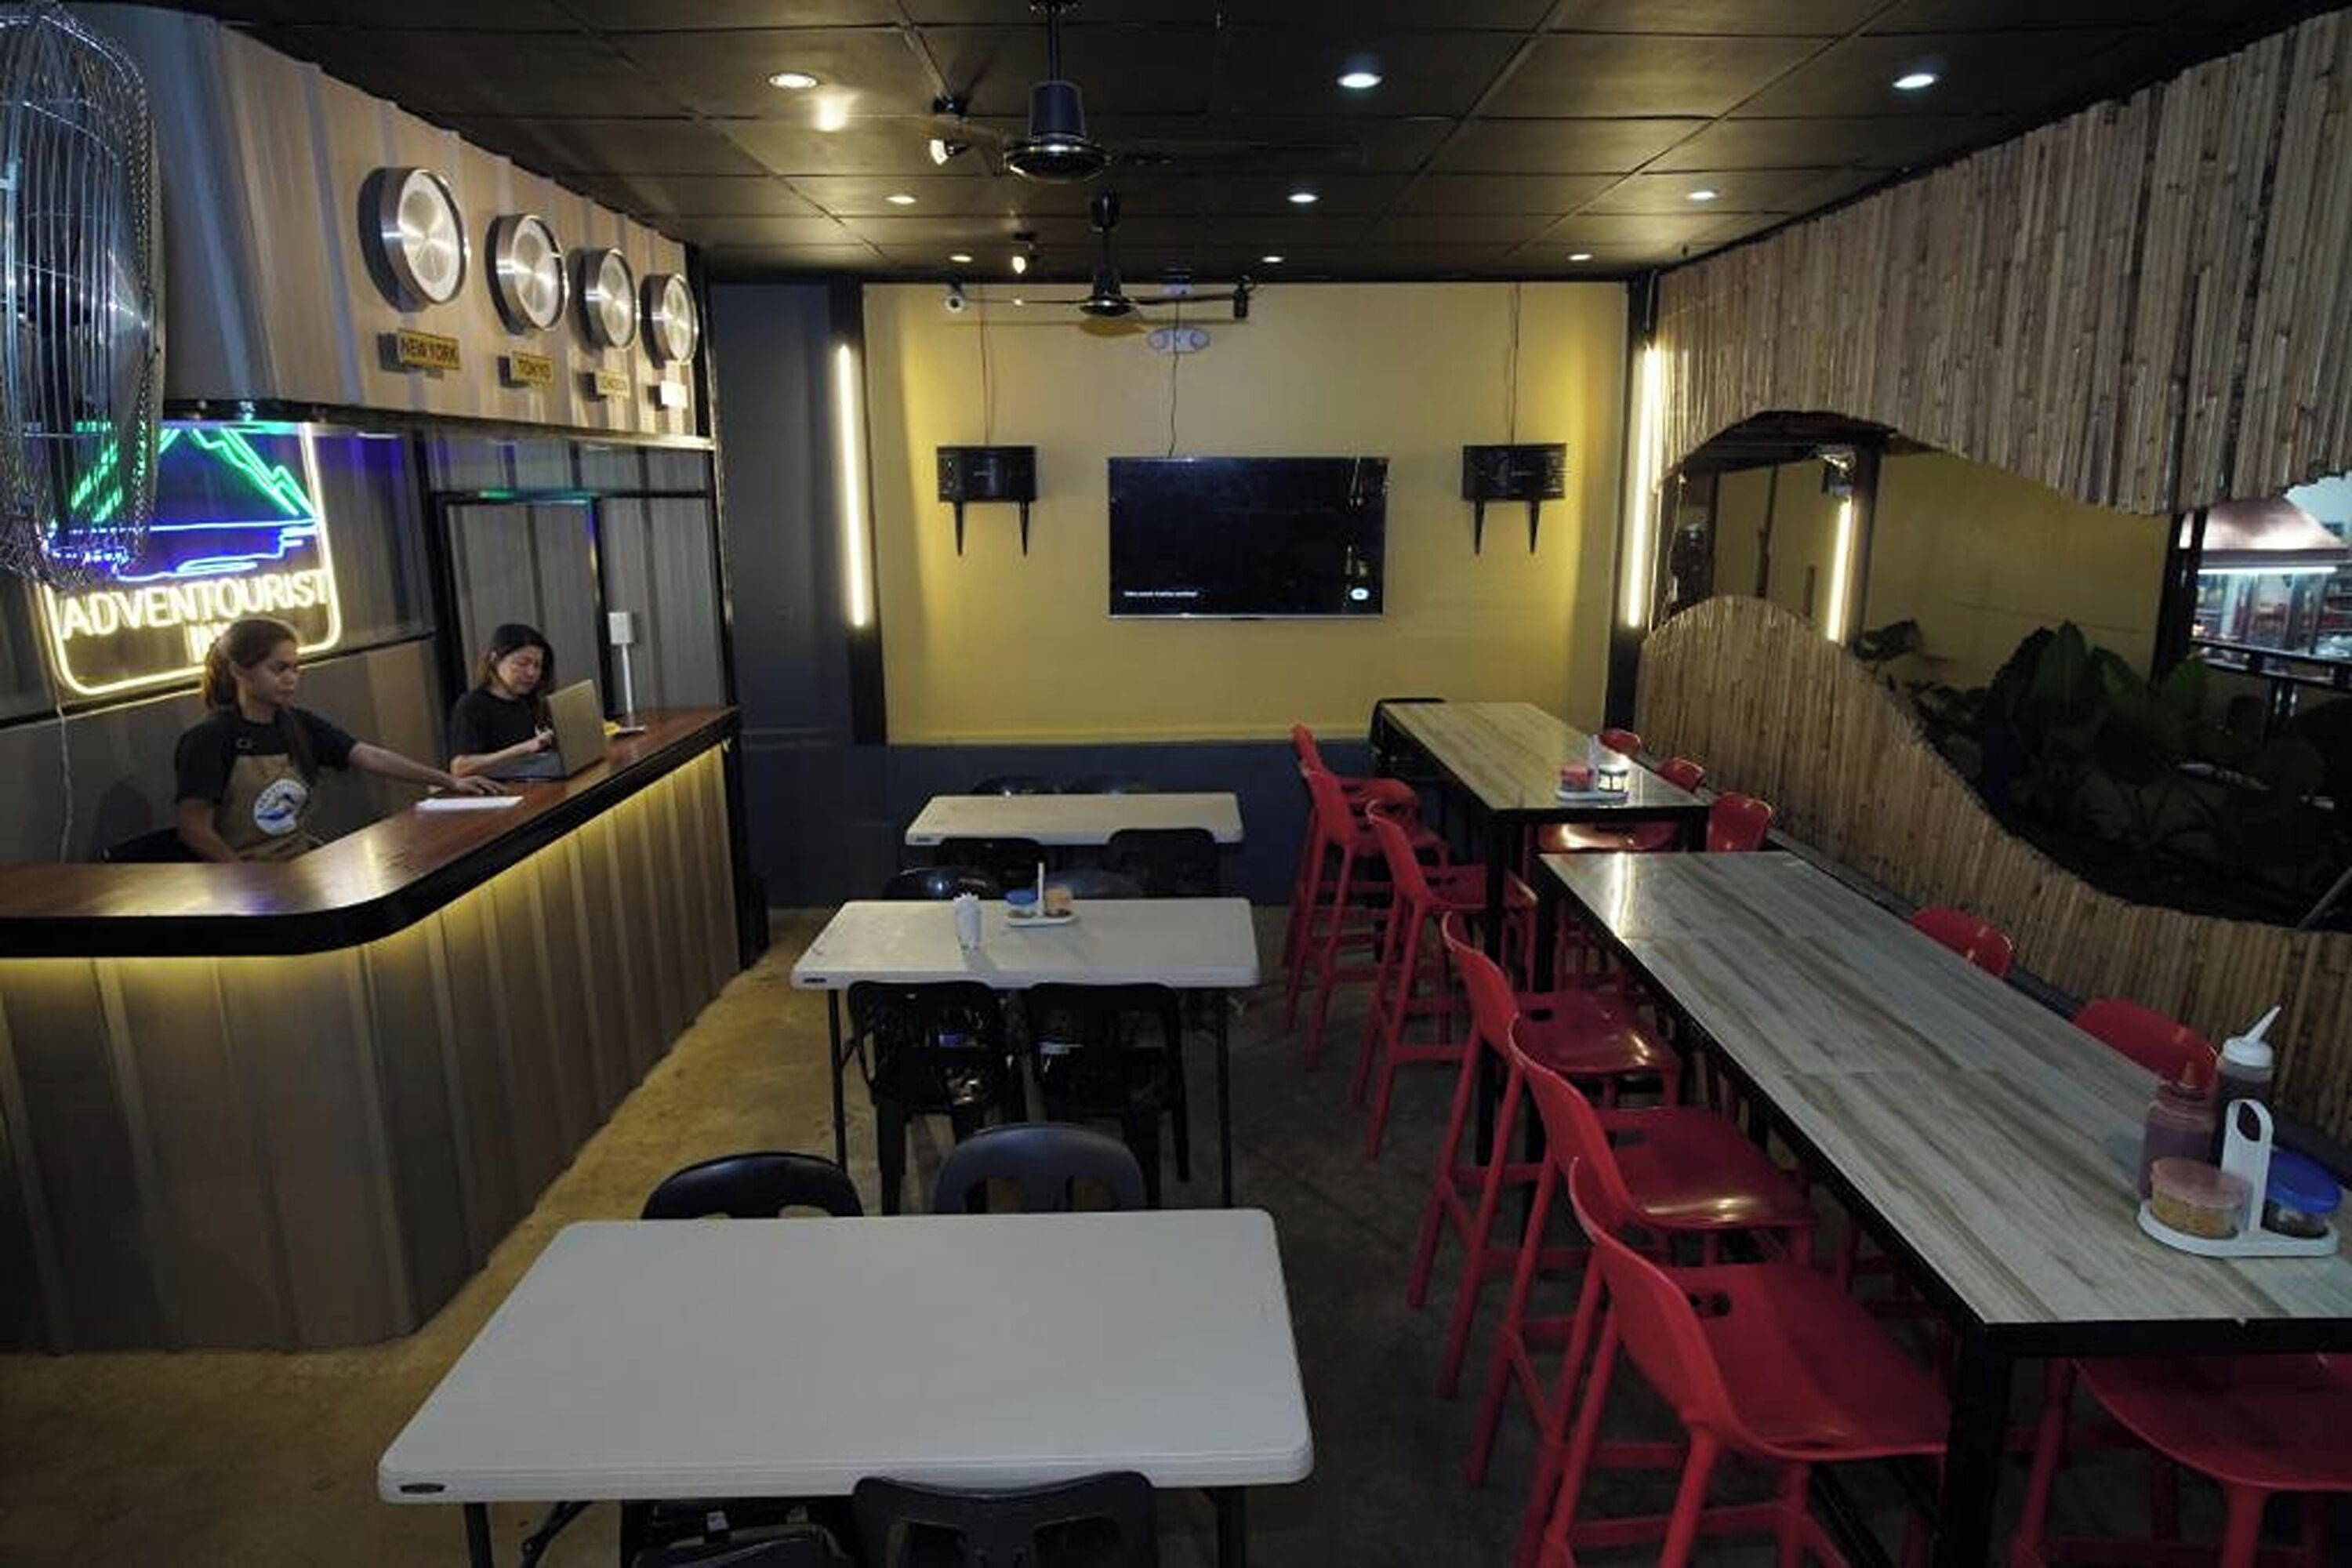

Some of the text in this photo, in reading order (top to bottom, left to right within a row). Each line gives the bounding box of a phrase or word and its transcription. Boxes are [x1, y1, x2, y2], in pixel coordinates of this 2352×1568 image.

[401, 336, 457, 363] NEW YORK
[61, 568, 328, 641] ADVENTOURIST
